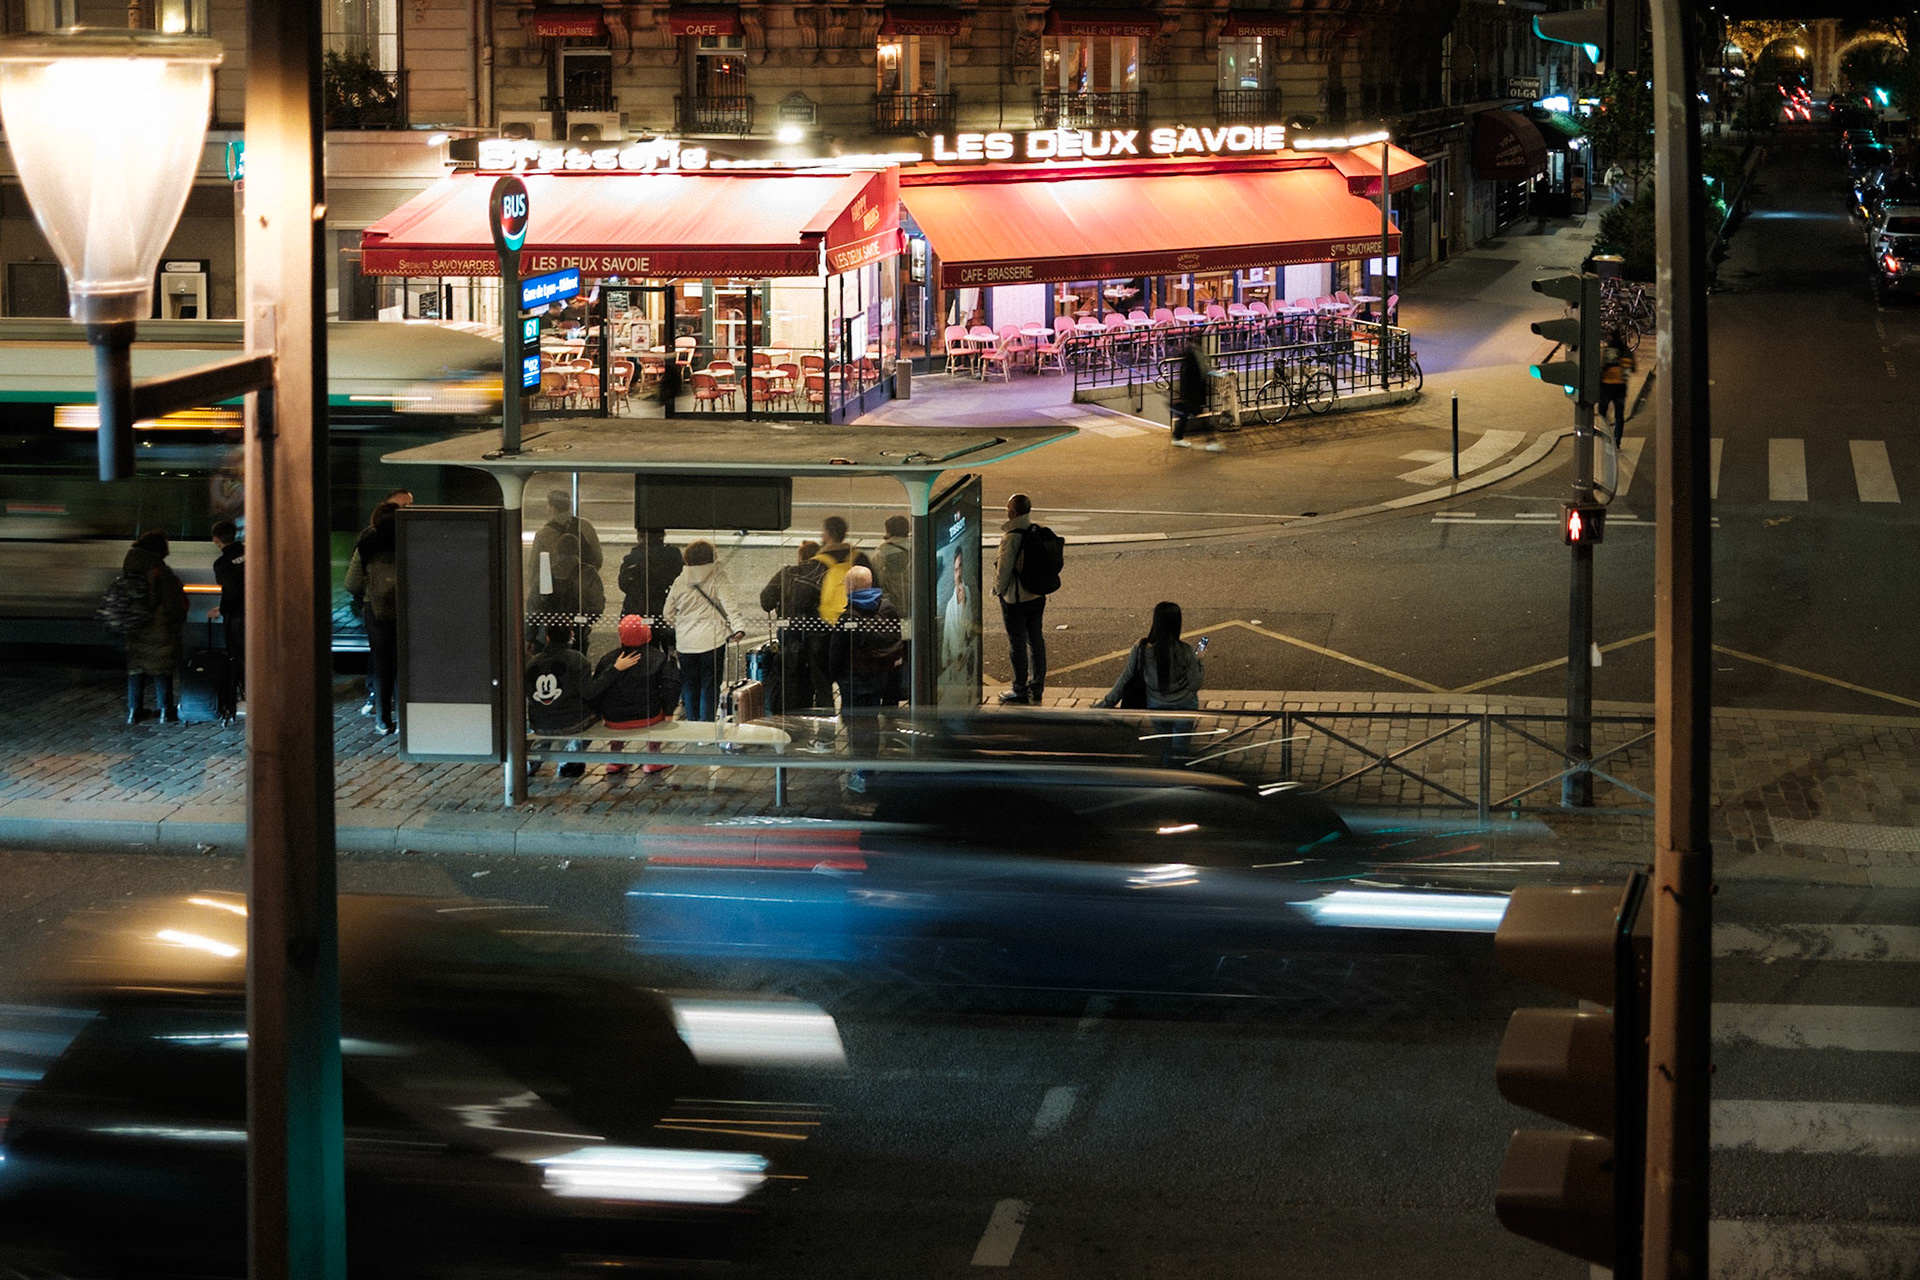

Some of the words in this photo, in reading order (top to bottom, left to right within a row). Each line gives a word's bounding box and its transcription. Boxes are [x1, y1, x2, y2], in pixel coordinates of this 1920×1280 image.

[686, 25, 716, 35] CAFE
[899, 25, 957, 35] COCKTAILS
[1071, 26, 1097, 35] SALLE
[1123, 26, 1151, 35] ETAGE
[1238, 27, 1287, 36] BRASSERIE
[934, 132, 1014, 161] LES
[1026, 128, 1140, 159] DEUX
[1150, 125, 1286, 154] SAVOIE
[478, 139, 709, 172] Brasserie
[503, 193, 526, 219] BUS
[835, 252, 849, 268] LES
[862, 241, 880, 260] SAVOIE
[432, 260, 496, 270] SAVOYARDES
[532, 256, 557, 271] LES
[561, 256, 599, 271] DEUX
[601, 257, 650, 272] SAVOIE
[525, 320, 537, 337] 61
[949, 516, 966, 538] TISSOT
